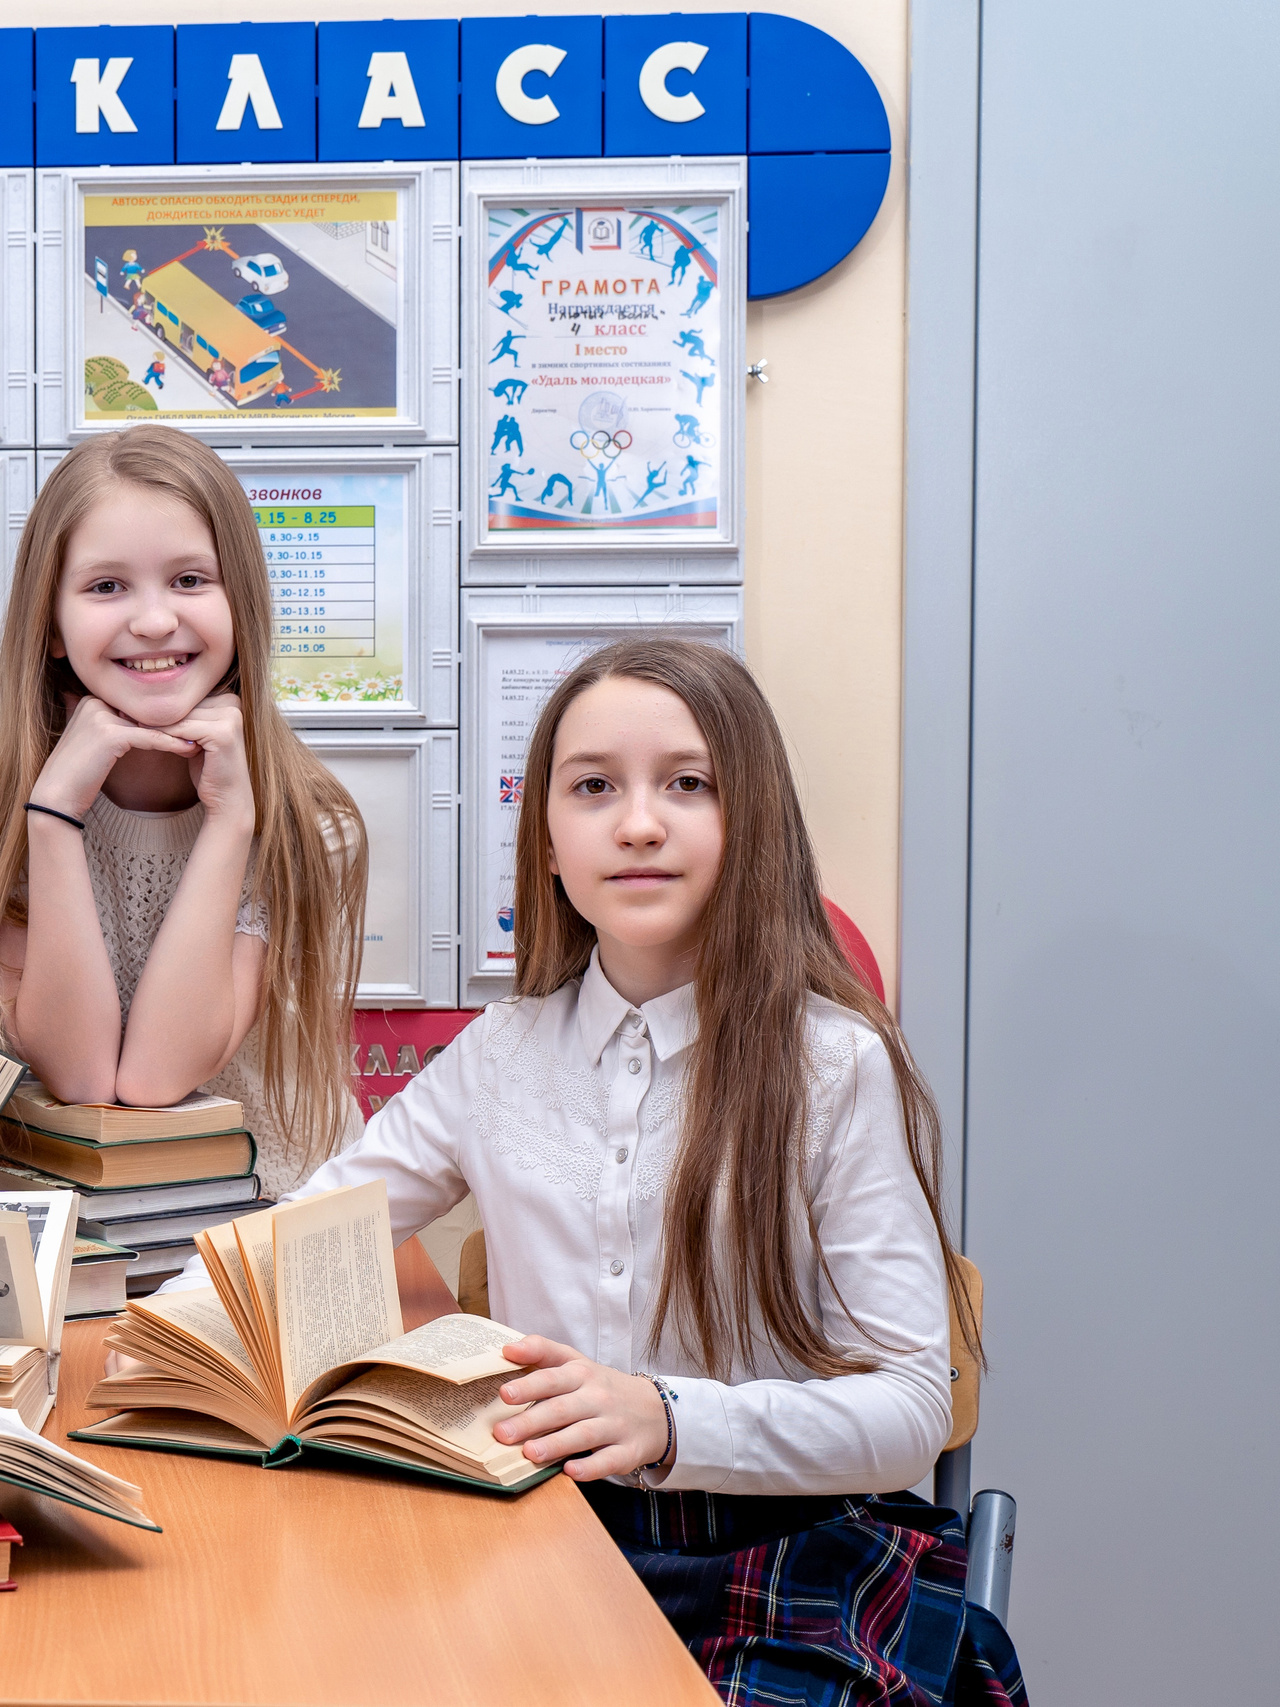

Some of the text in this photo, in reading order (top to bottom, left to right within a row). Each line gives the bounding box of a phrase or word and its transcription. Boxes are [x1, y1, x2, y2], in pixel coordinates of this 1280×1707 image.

[70, 41, 710, 135] КЛАСС
[112, 193, 360, 206] АВТОБУС ОПАСНО ОБХОДИТЬ СЗАДИ И СПЕРЕДИ,
[147, 208, 325, 221] ДОЖДИТЕСЬ ПОКА АВТОБУС УЕДЕТ
[541, 278, 660, 296] ГРАМОТА
[548, 302, 655, 317] Награждается
[594, 323, 647, 336] класс
[584, 345, 628, 356] место
[570, 361, 619, 370] спортивных
[531, 375, 671, 387] «Удаль молодецкая»
[249, 488, 322, 501] звонков
[304, 511, 337, 524] 8.25
[270, 533, 320, 542] 8.30-9.15
[267, 551, 322, 560] 9.30-10.15
[270, 569, 326, 579] 0.30-11.15
[270, 588, 326, 597] 1.30-12.15
